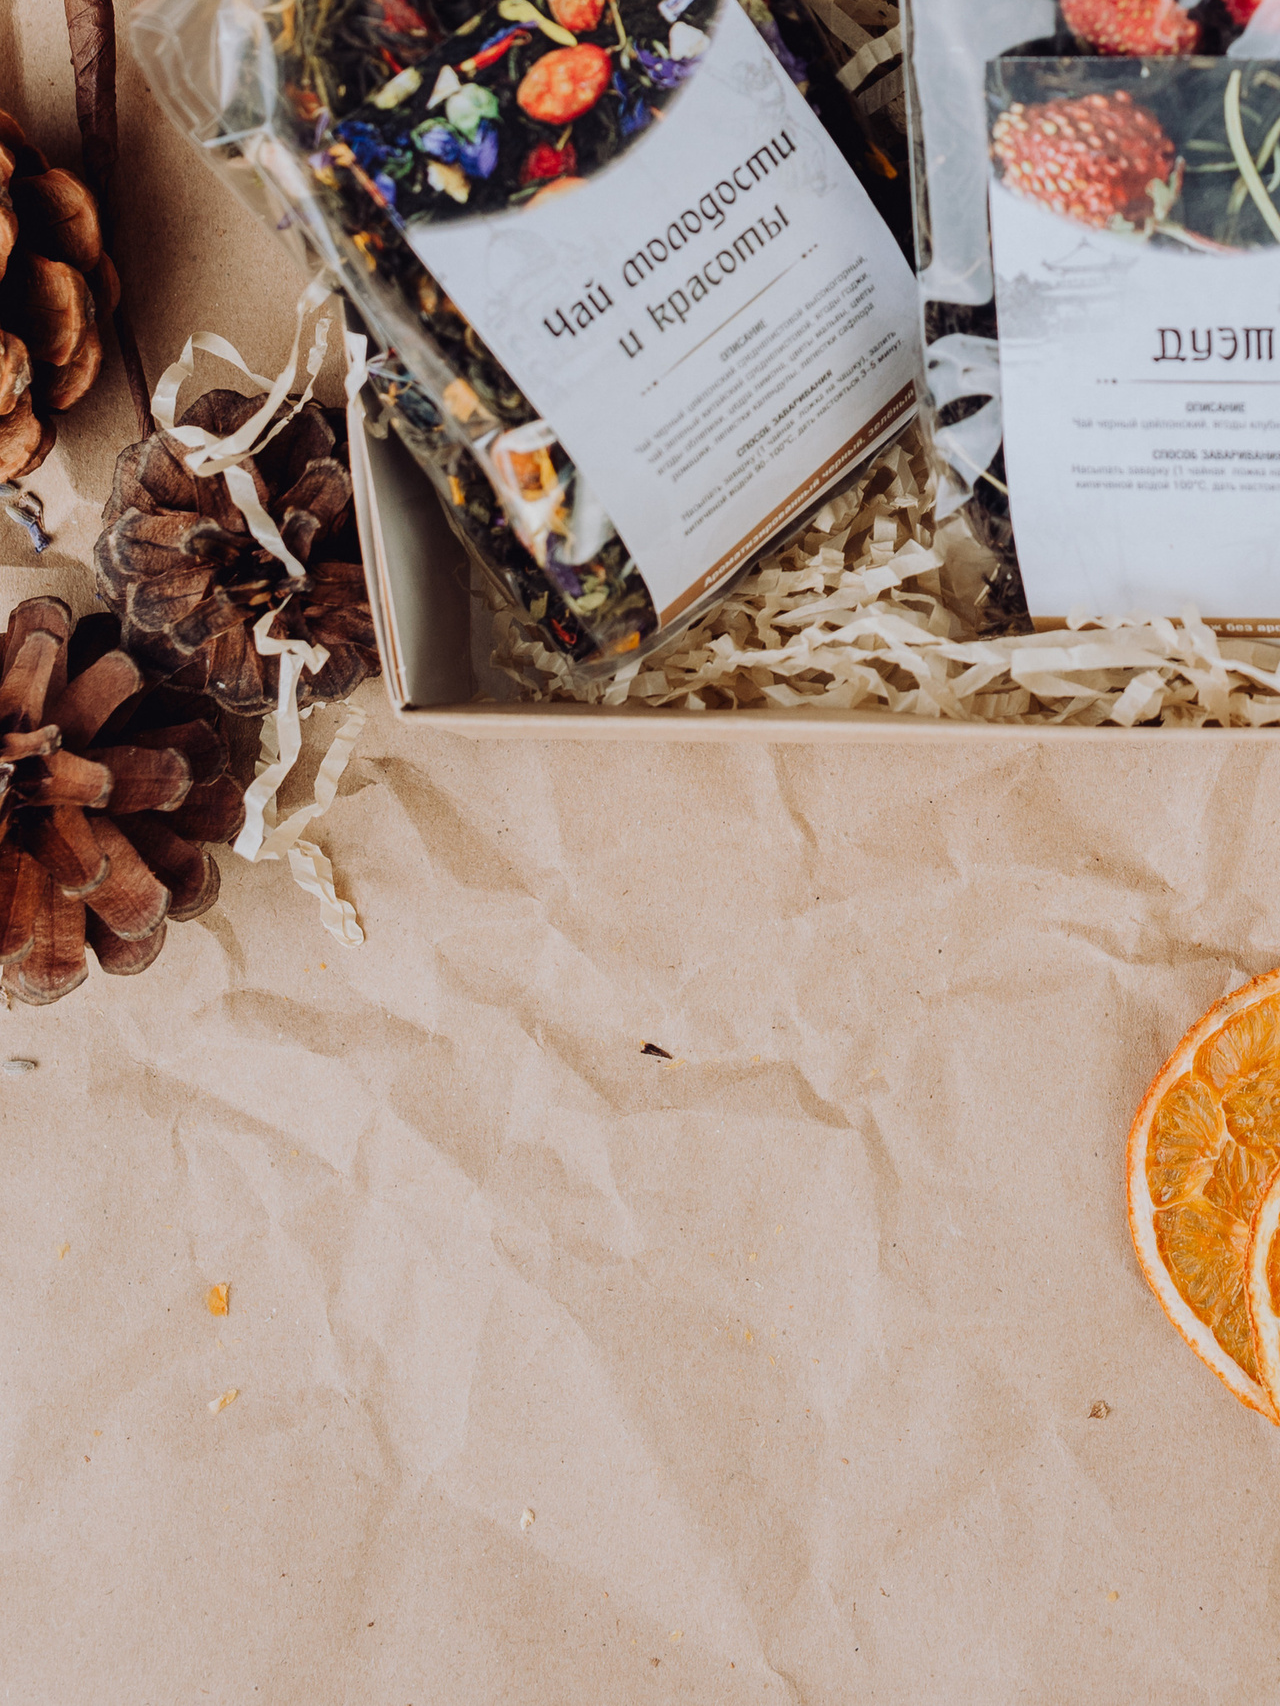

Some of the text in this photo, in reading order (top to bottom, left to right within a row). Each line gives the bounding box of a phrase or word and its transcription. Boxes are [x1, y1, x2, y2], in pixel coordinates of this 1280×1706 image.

[542, 129, 797, 338] Чай молодости
[618, 204, 790, 359] и красоты
[1153, 327, 1274, 363] ДУЭТ
